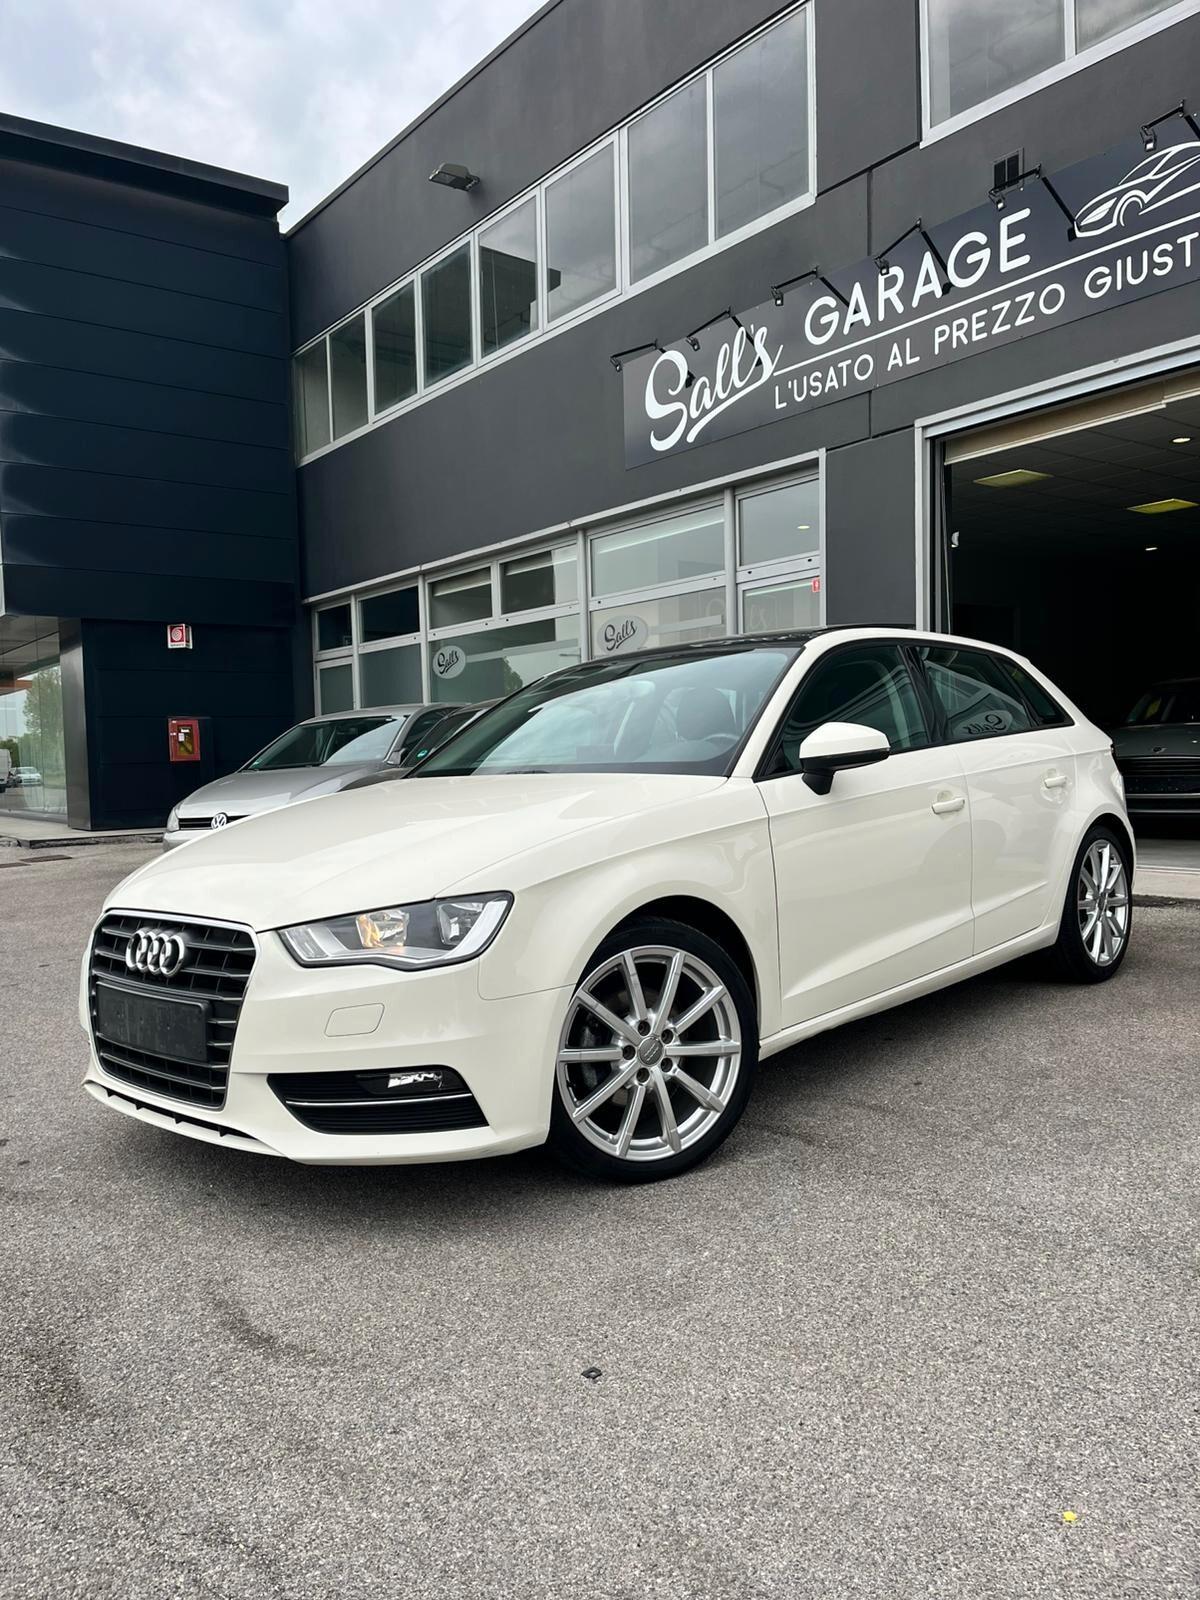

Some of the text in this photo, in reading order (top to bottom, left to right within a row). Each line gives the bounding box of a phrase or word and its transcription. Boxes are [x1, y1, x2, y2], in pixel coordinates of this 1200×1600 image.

[645, 207, 1031, 451] Sall's GARAGE
[774, 353, 874, 409] L'USATO
[887, 337, 920, 371] AL
[934, 283, 1066, 355] PREZZO
